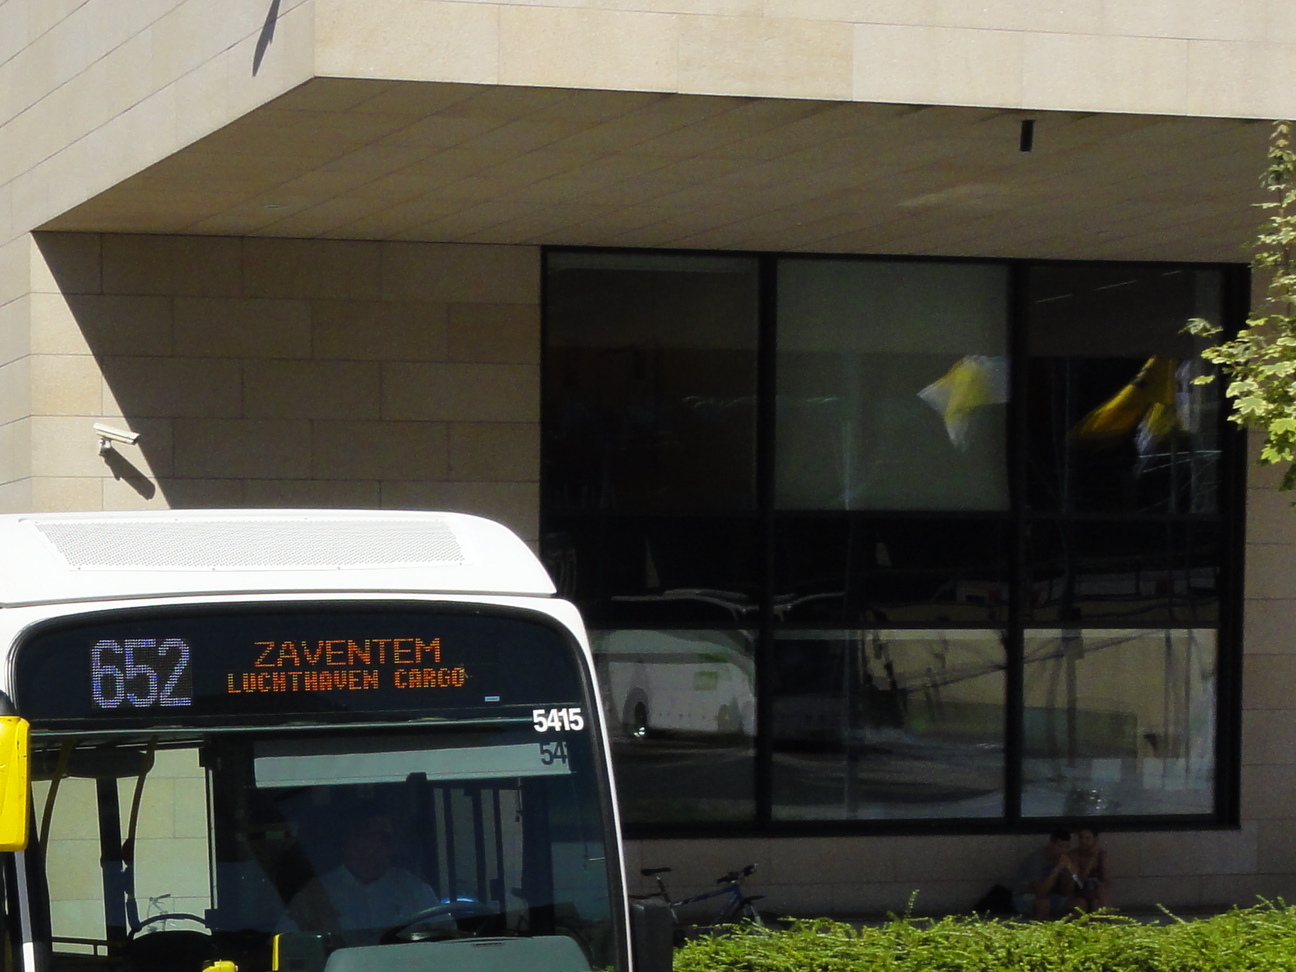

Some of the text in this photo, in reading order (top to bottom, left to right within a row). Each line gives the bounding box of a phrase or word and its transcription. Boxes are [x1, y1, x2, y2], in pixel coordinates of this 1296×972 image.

[254, 636, 441, 668] ZAVENTEM
[90, 637, 193, 708] 652
[227, 666, 467, 694] LUCHTHAVEN CARGO
[532, 707, 585, 733] 5415
